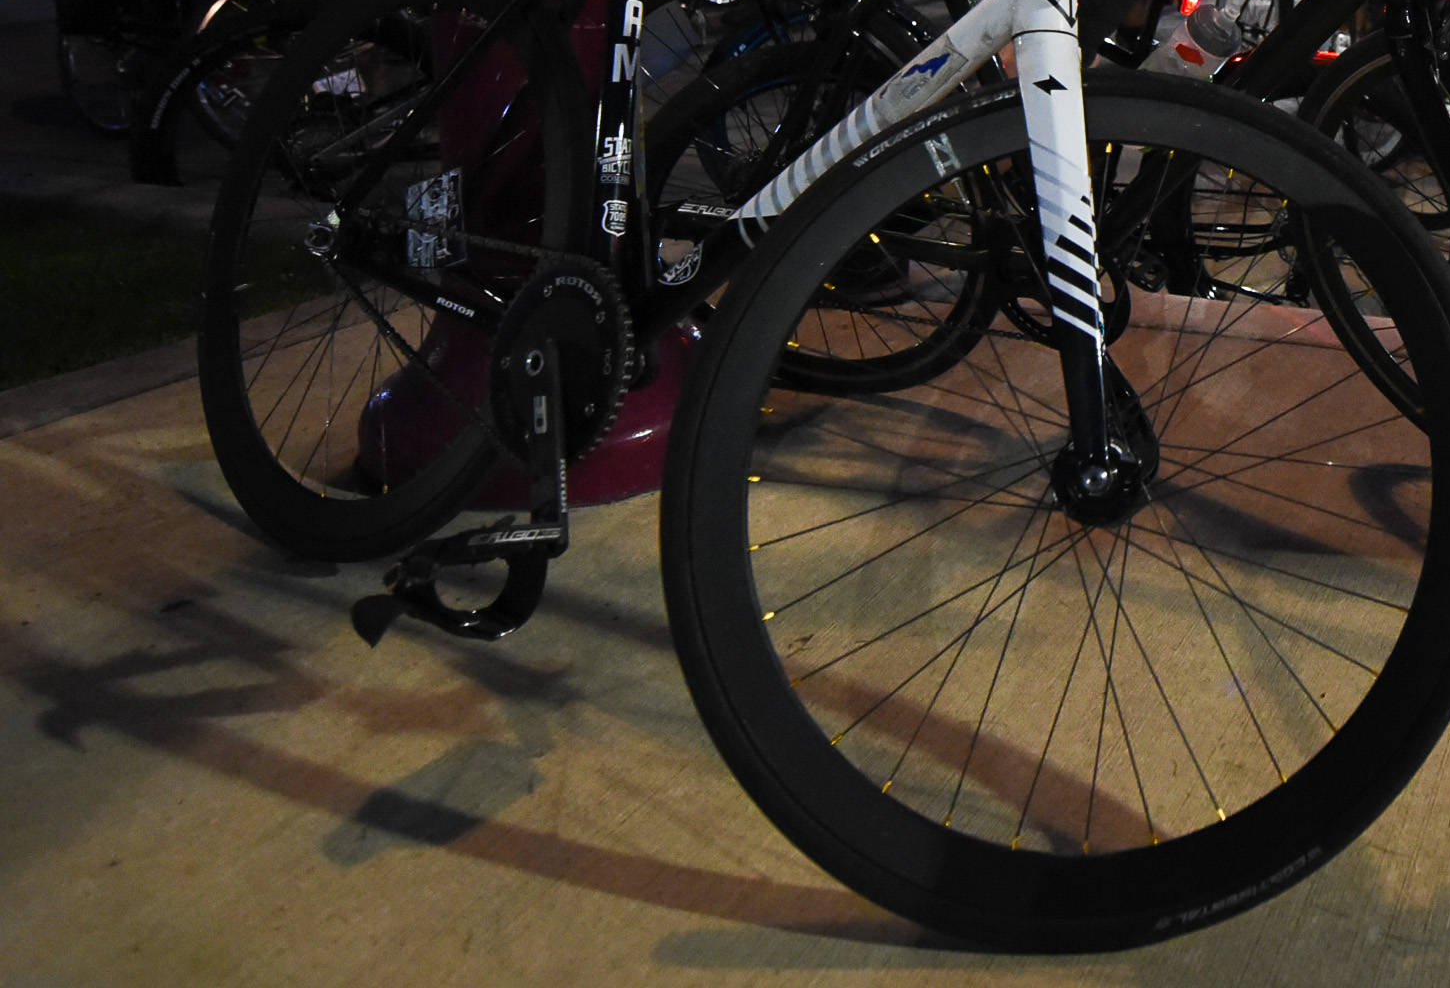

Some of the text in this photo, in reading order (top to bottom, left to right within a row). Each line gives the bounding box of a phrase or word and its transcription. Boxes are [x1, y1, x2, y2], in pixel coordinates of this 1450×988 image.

[554, 275, 603, 307] ROTOR
[435, 296, 476, 319] ROTOR
[559, 459, 568, 513] ROTOR
